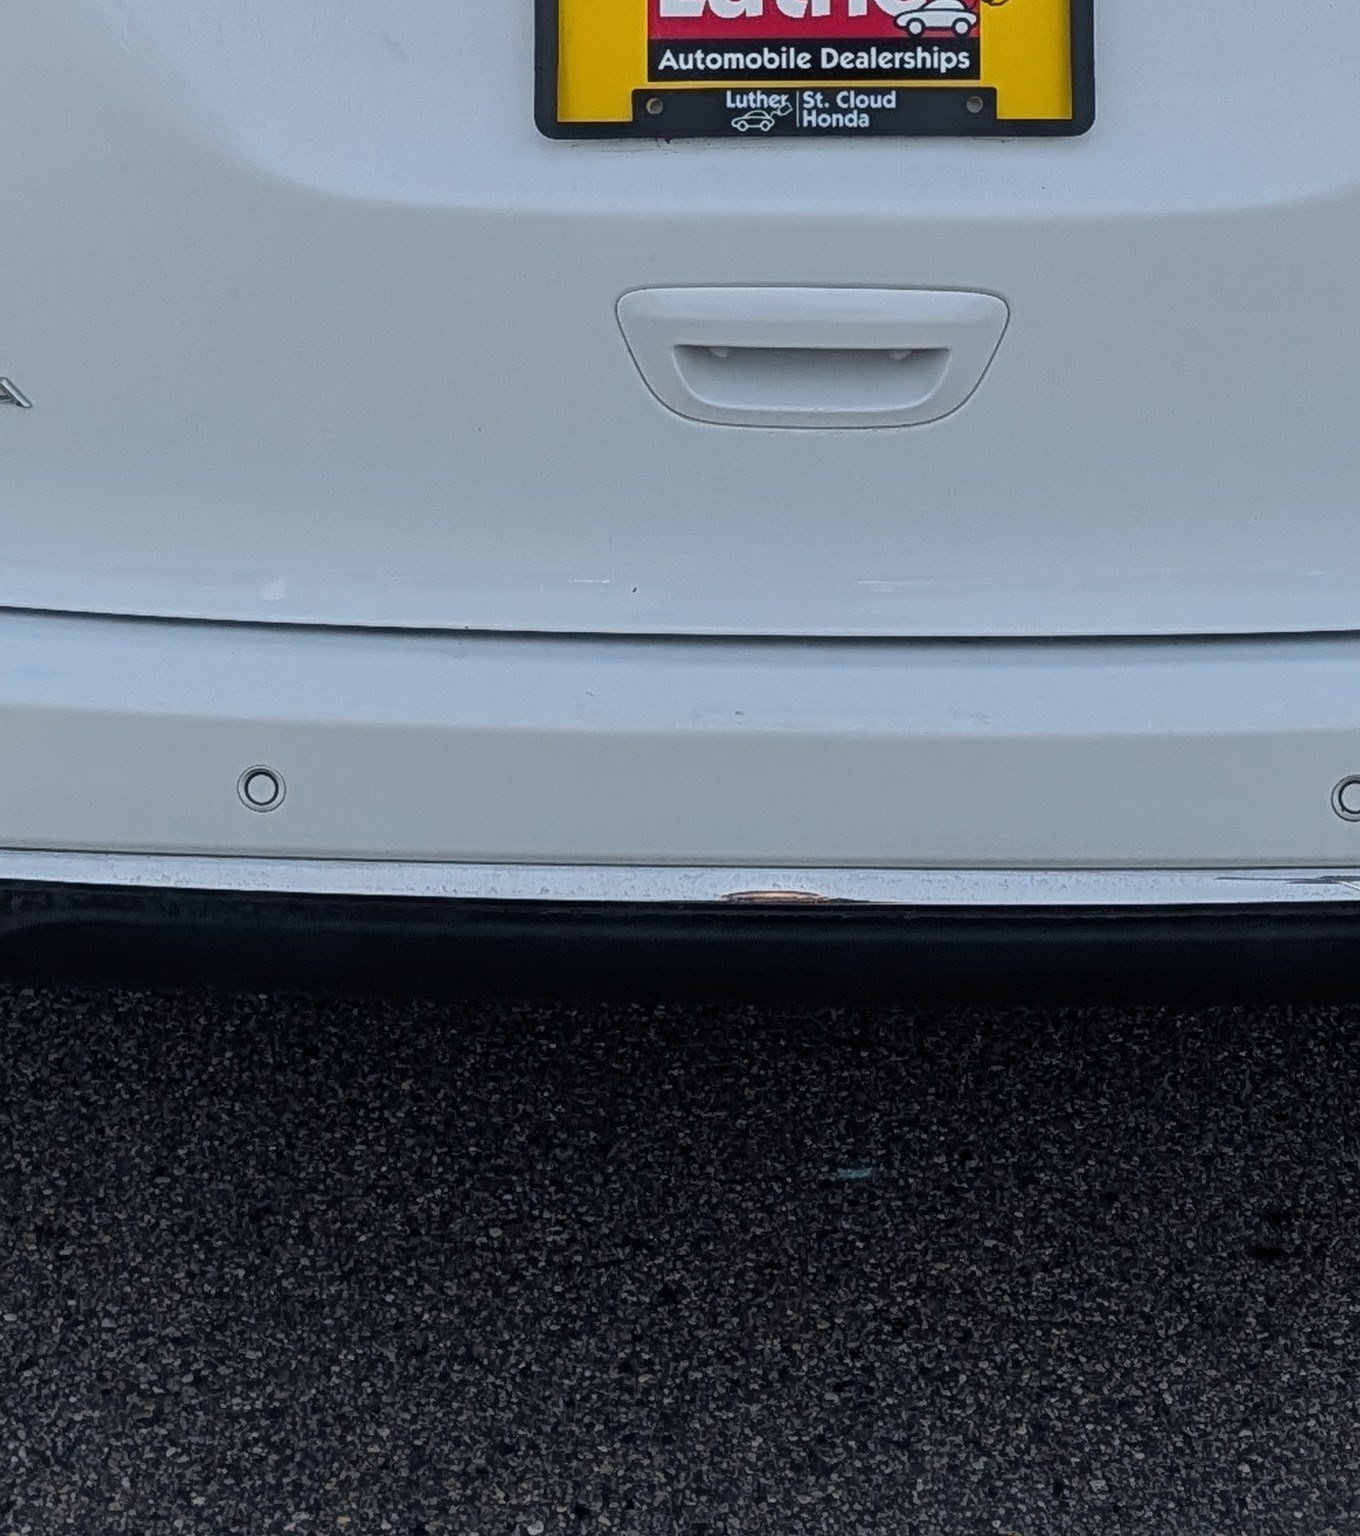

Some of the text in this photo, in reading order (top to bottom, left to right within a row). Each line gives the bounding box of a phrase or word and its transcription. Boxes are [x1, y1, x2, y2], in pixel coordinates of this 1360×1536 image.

[657, 47, 971, 74] Automobile Dealerships
[726, 90, 897, 109] Luther St. Cloud
[802, 109, 871, 128] Honda
